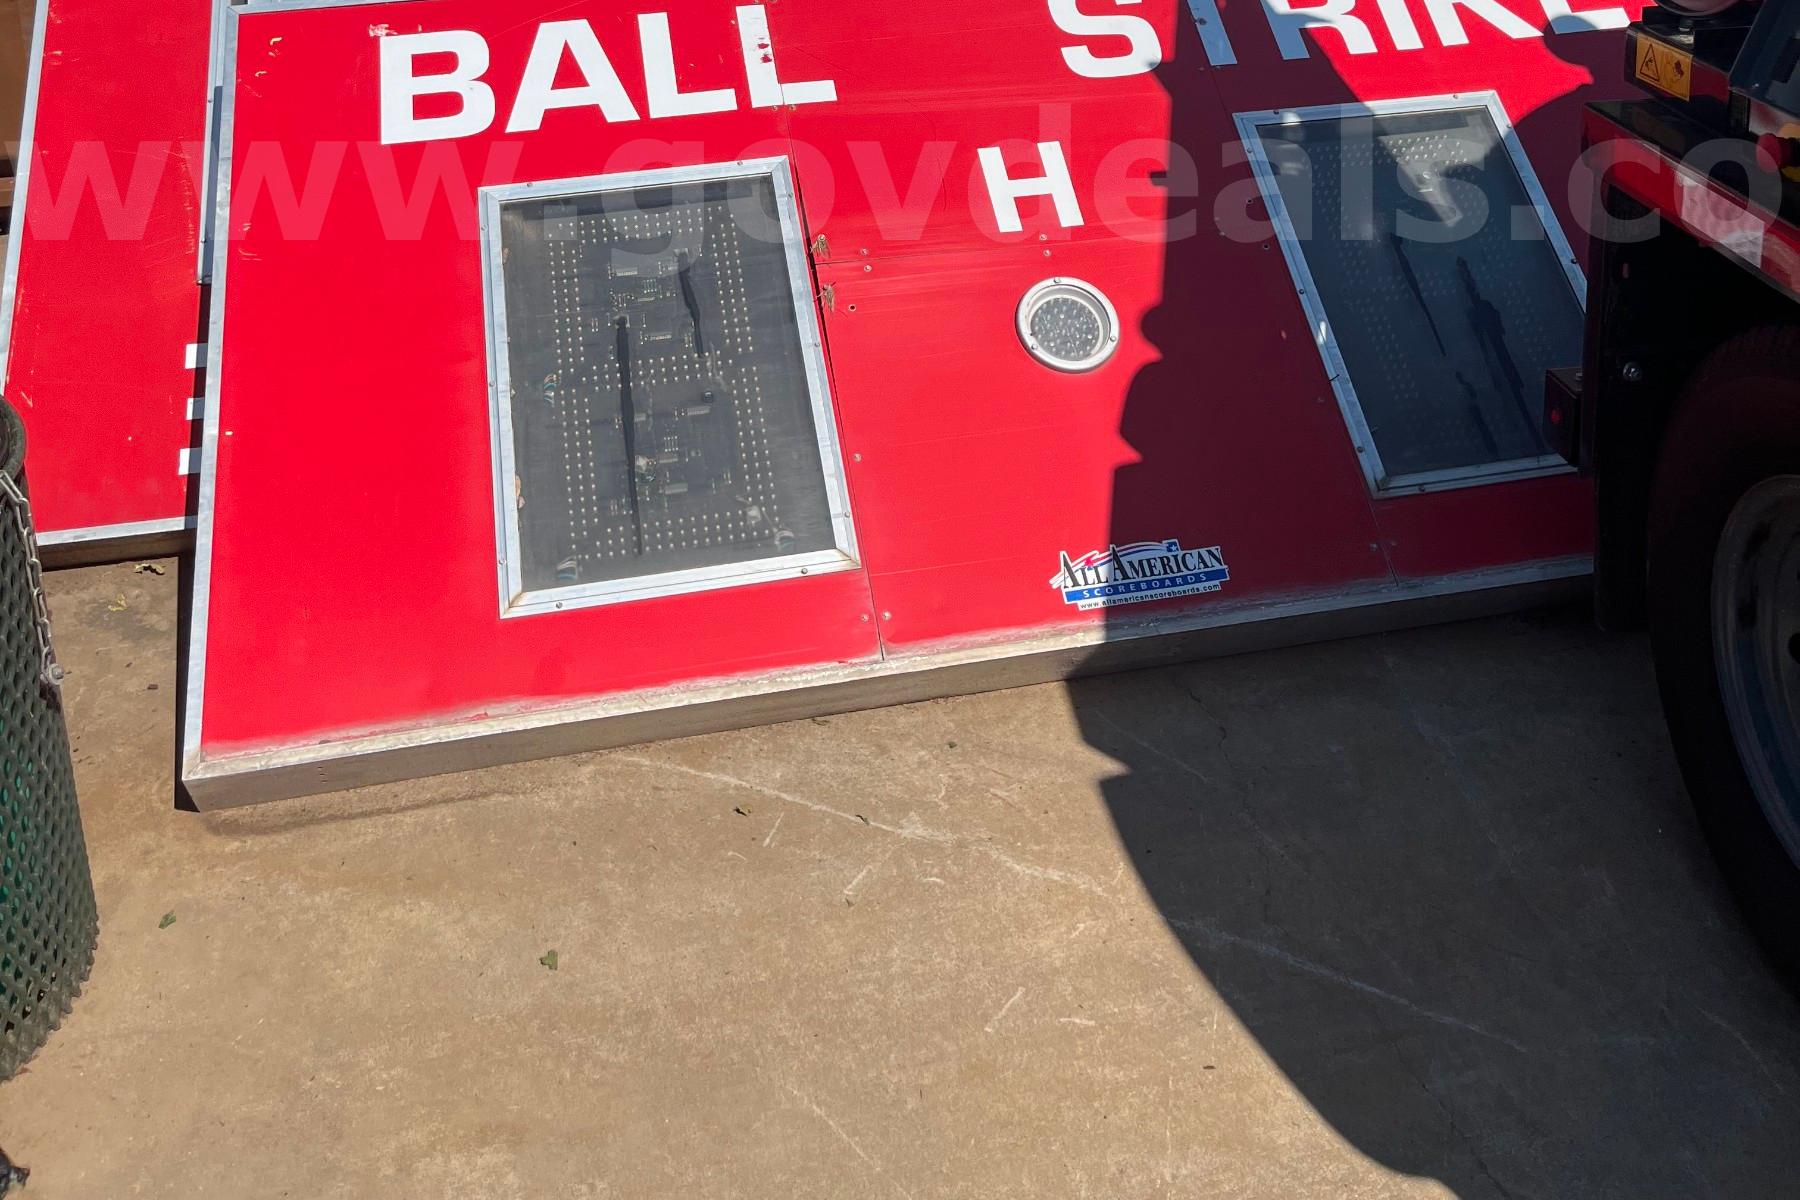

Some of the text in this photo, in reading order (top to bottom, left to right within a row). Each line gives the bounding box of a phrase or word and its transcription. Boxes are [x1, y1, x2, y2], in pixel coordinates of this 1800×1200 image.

[379, 5, 837, 145] BALL
[976, 141, 1084, 232] H
[1080, 583, 1221, 609] www.allamericanscoreboards.com
[1083, 573, 1207, 598] SCOREBOARDS
